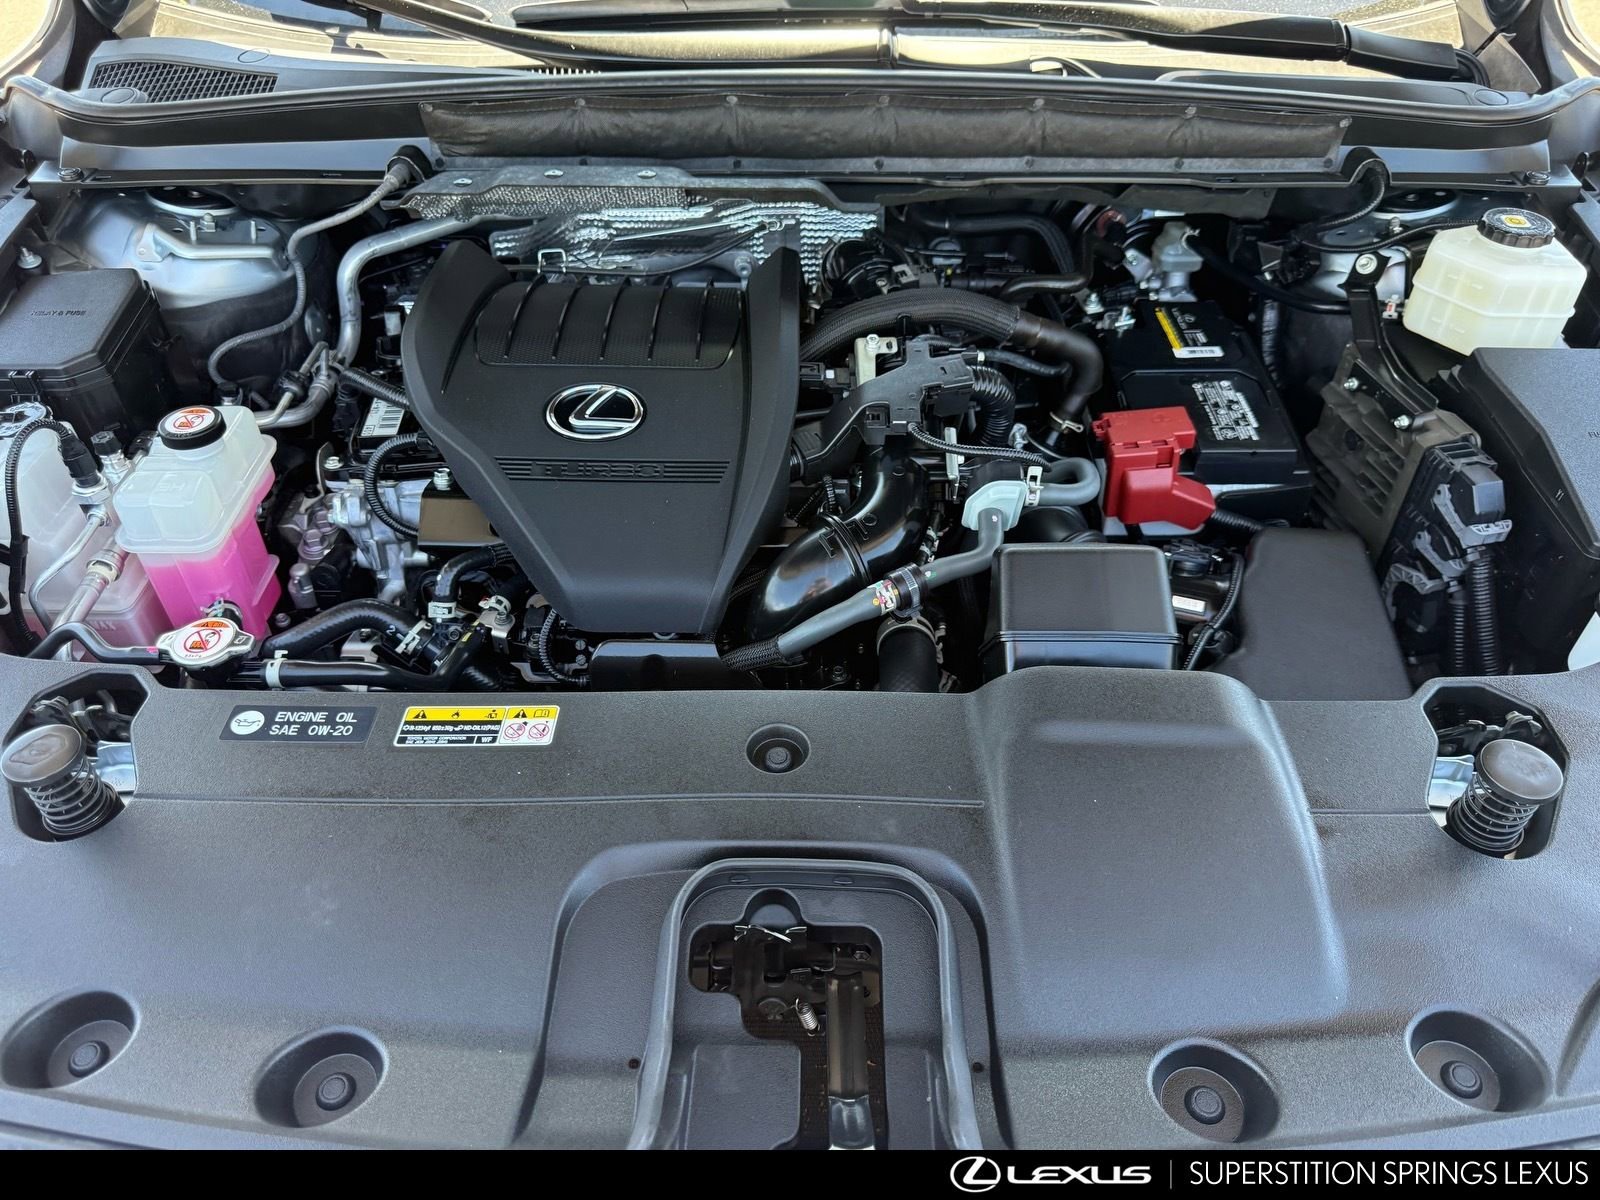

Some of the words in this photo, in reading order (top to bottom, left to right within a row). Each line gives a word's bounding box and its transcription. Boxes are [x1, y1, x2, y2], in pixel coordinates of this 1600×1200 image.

[274, 711, 328, 723] ENGINE
[335, 712, 358, 723] OIL
[269, 724, 300, 736] SAE
[307, 725, 354, 736] 0W-20
